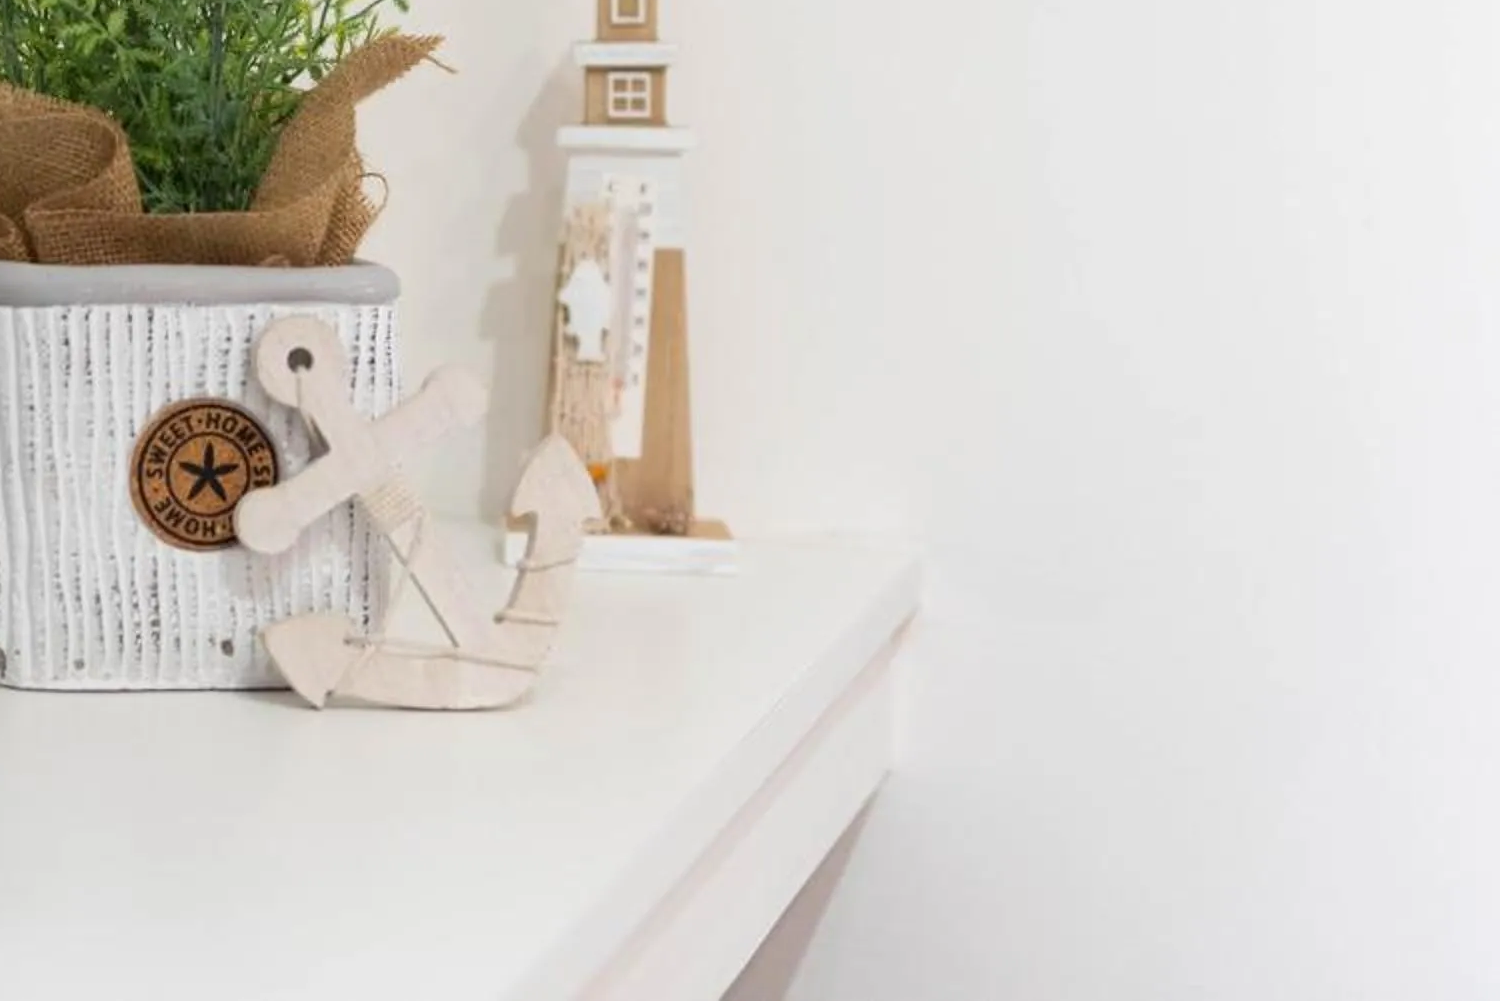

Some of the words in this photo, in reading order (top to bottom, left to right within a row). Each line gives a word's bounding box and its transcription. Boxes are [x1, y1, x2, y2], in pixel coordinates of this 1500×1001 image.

[146, 414, 195, 479] SWEET
[204, 412, 264, 456] HOME
[154, 496, 216, 537] HOME
